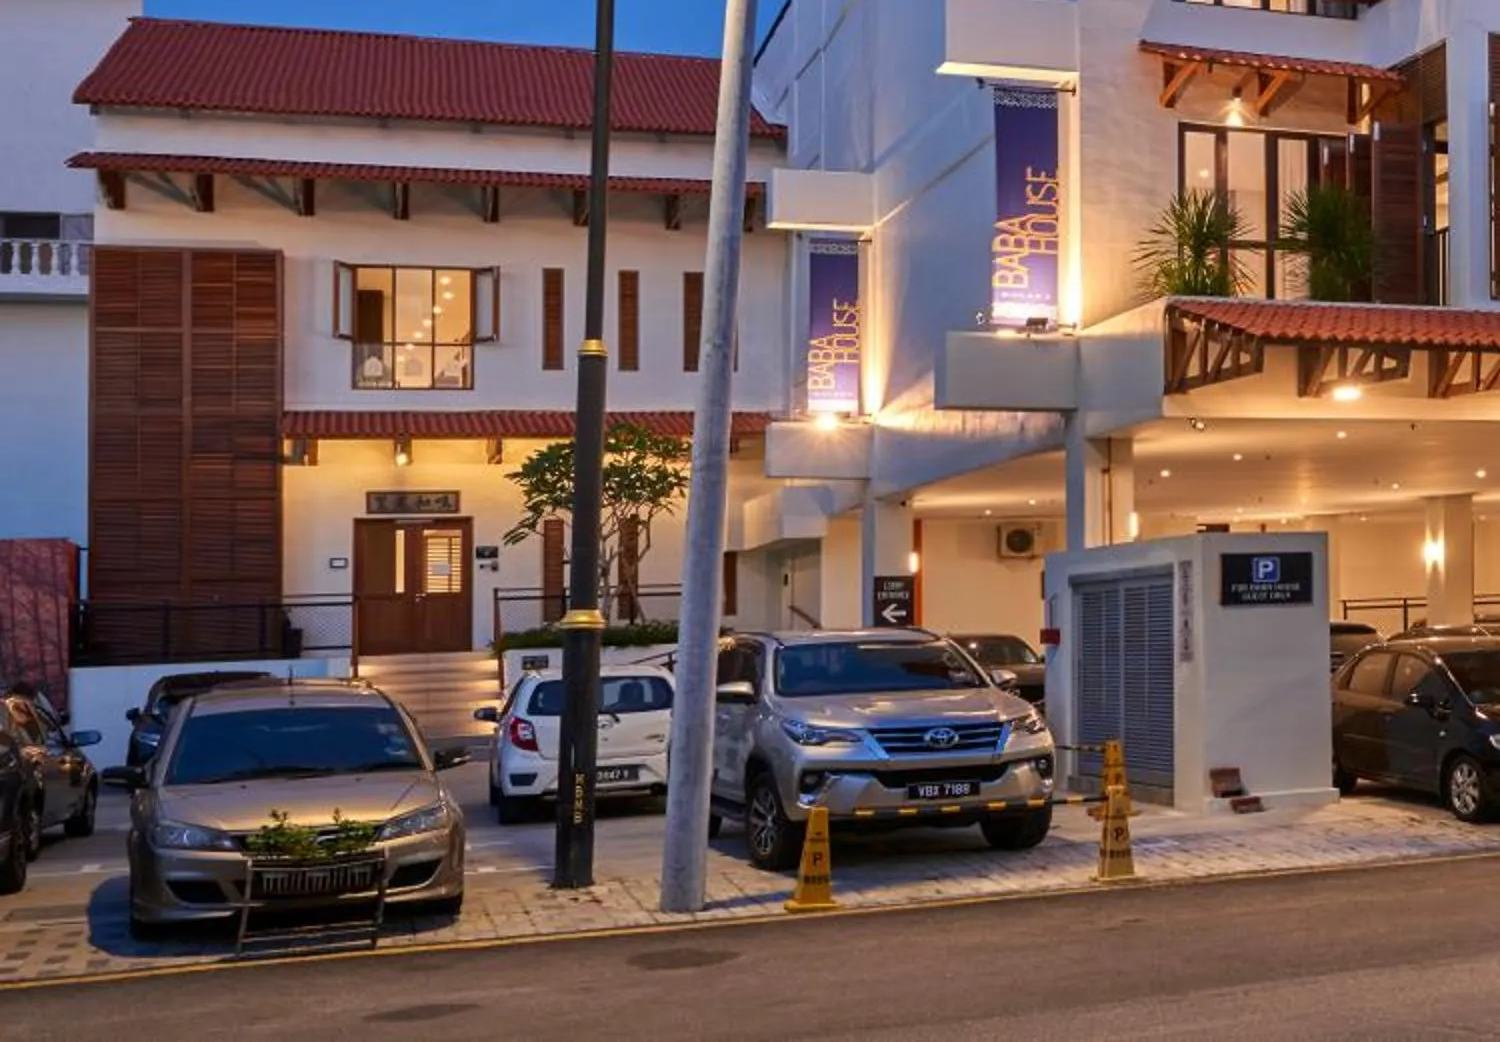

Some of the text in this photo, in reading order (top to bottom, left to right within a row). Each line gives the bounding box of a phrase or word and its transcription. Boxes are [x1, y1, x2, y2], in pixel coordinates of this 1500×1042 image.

[1026, 166, 1058, 255] HOUSE
[993, 216, 1029, 289] BABA
[807, 335, 835, 390] BABA
[832, 298, 859, 363] HOUSE
[1259, 561, 1274, 578] P
